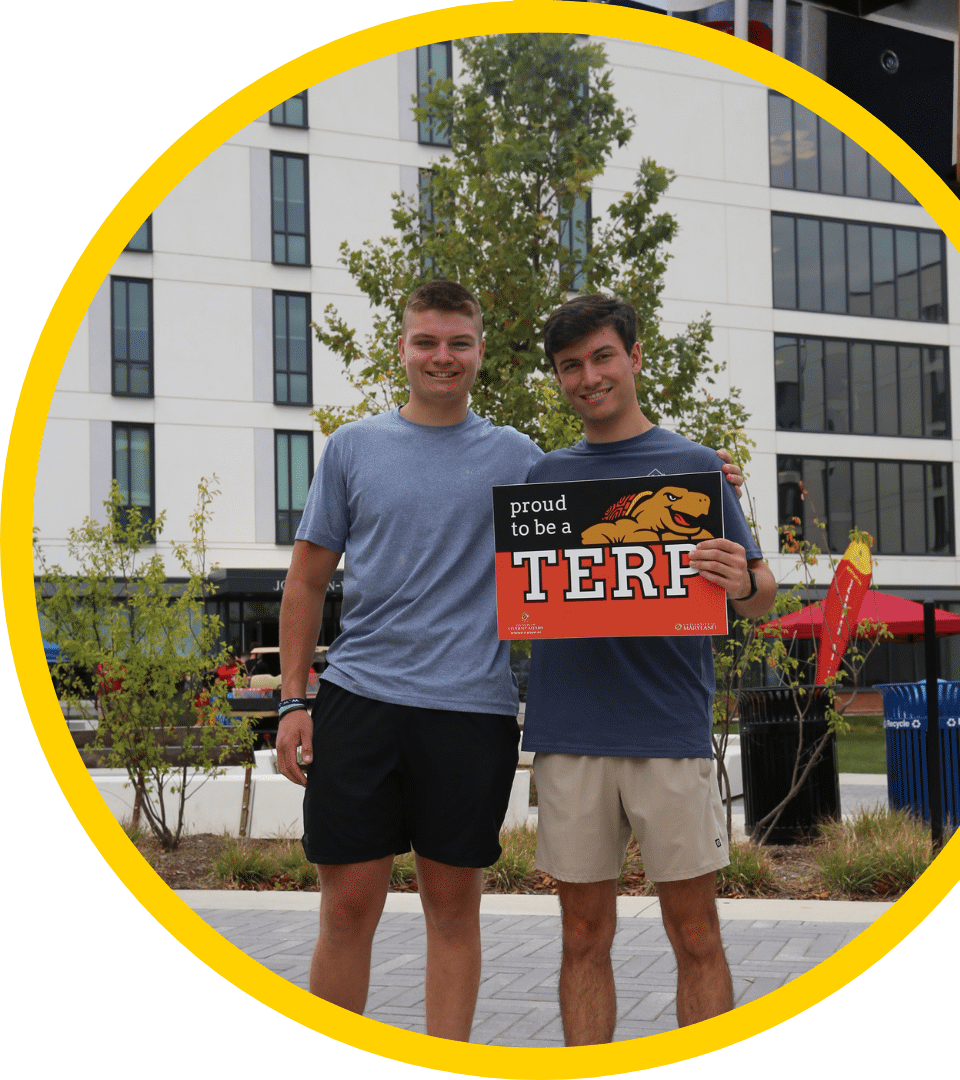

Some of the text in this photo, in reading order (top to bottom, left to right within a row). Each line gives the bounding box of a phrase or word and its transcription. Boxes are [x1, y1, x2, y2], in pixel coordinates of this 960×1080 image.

[510, 495, 567, 518] proud
[511, 519, 572, 536] to be a
[511, 543, 700, 603] TERP
[887, 718, 910, 729] Recycle
